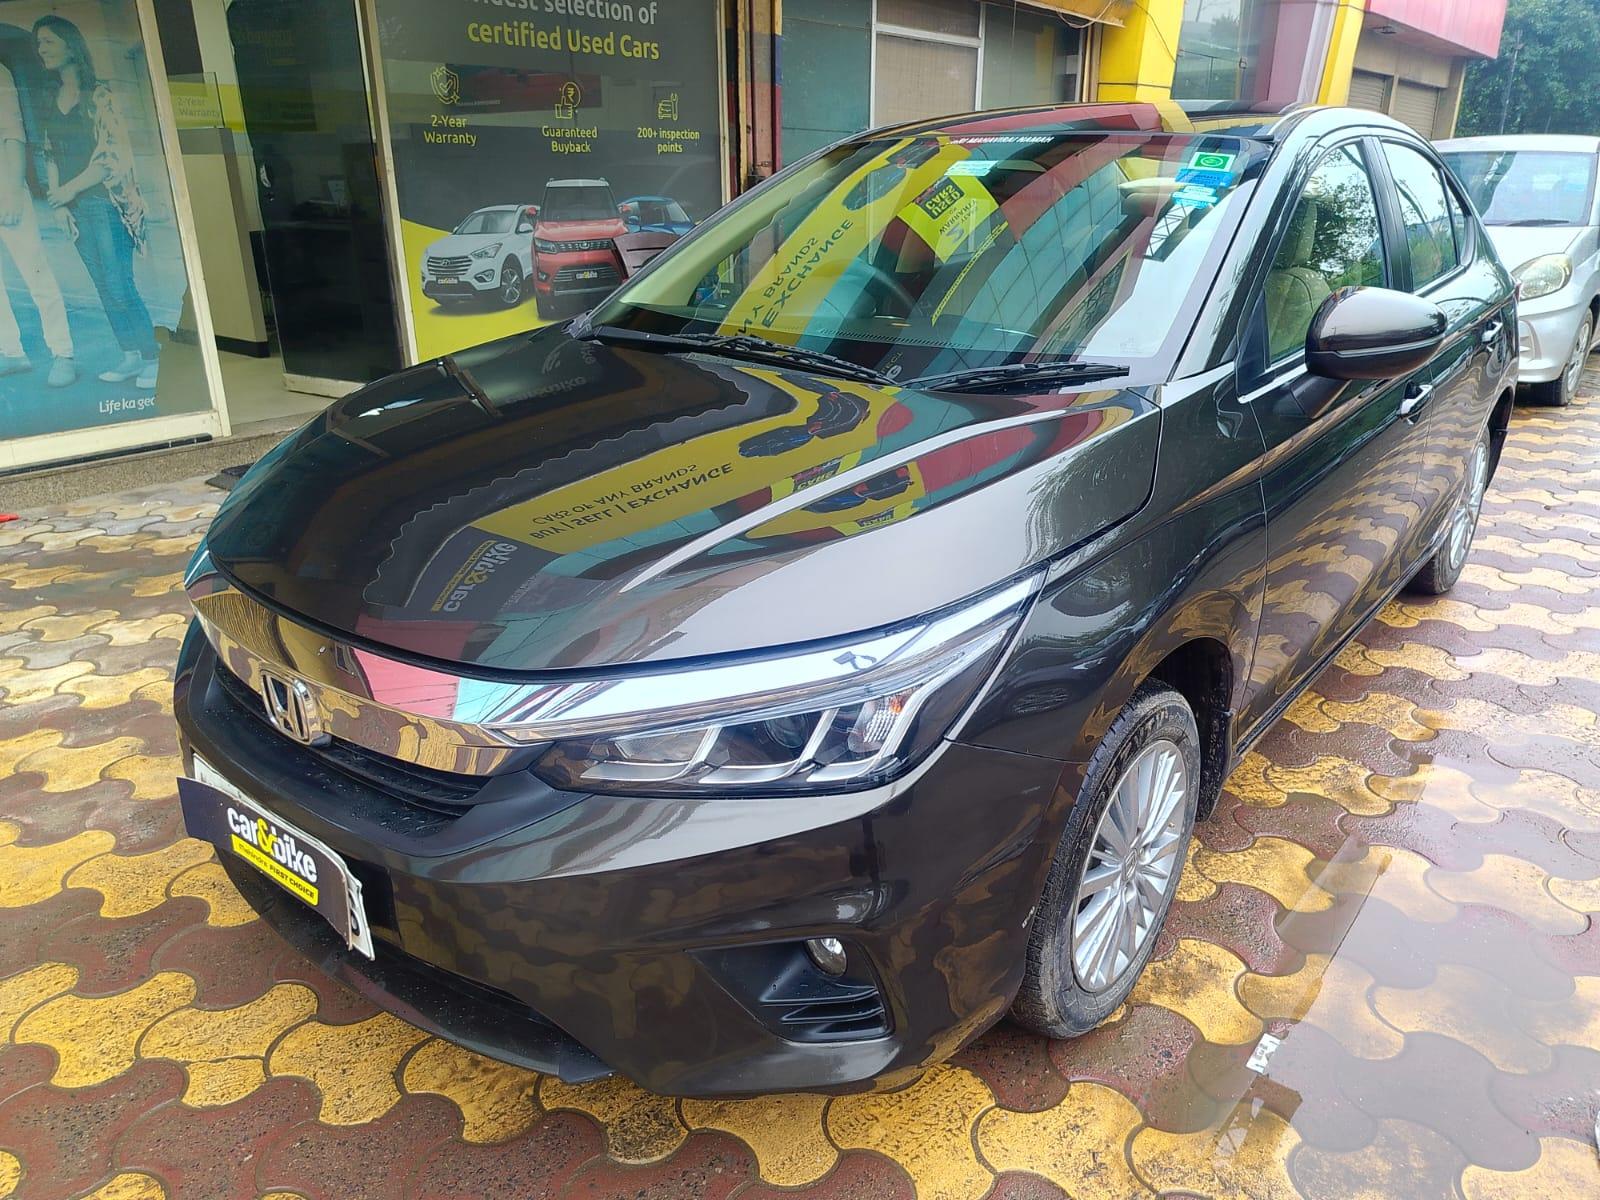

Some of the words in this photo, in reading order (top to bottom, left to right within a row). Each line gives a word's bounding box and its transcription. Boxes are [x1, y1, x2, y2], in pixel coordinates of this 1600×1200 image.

[544, 0, 633, 22] selection
[638, 2, 658, 25] of
[467, 20, 561, 50] certified
[567, 29, 615, 56] Used
[619, 34, 660, 60] Cars
[431, 114, 468, 128] 2-Year
[423, 130, 477, 147] Warranty
[541, 125, 598, 138] Guaranteed
[637, 127, 658, 139] 200+
[659, 127, 700, 141] inspection
[551, 140, 592, 155] Buyback
[657, 142, 683, 155] points
[99, 399, 121, 414] Life
[122, 397, 136, 410] ka
[227, 807, 318, 883] car&bike
